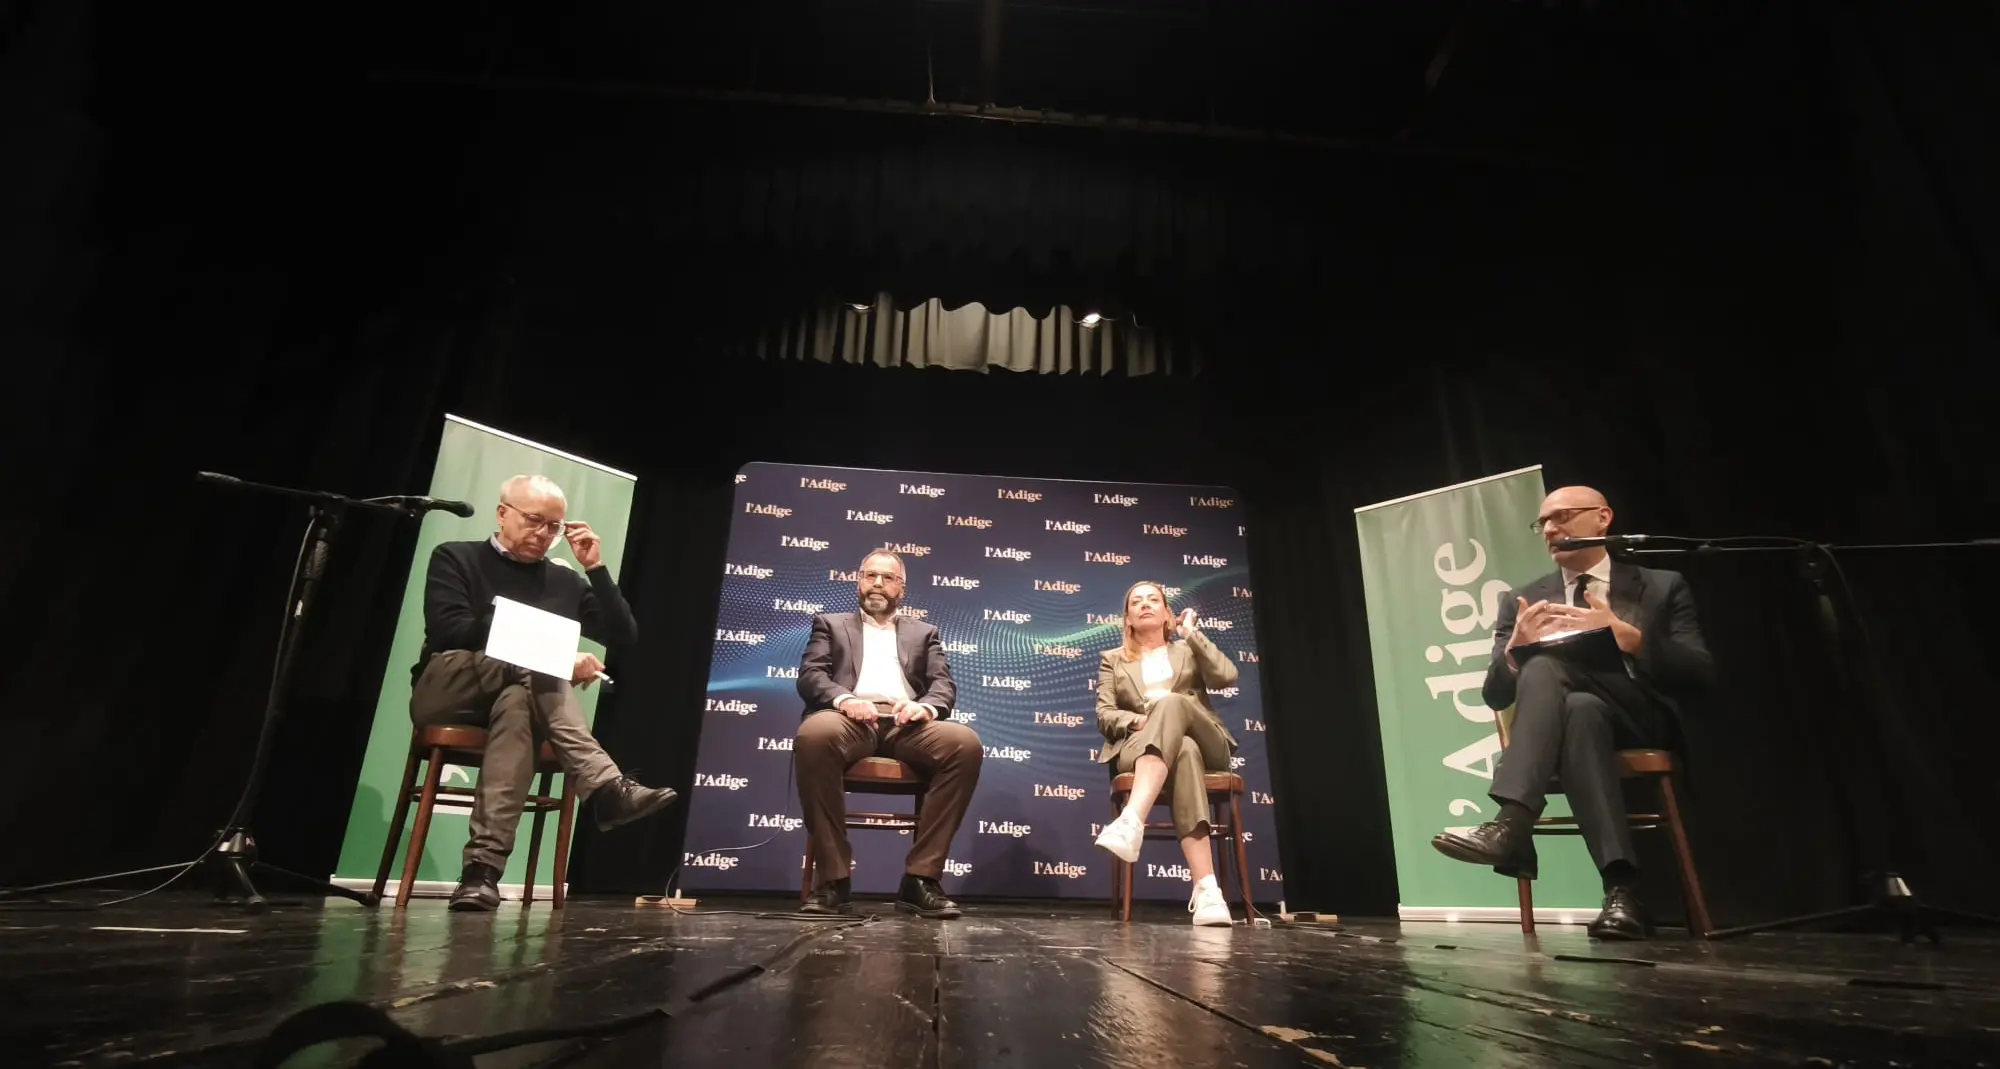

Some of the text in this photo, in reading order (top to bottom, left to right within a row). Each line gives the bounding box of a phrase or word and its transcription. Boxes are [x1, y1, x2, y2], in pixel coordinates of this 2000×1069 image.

[800, 477, 847, 492] l'Adige
[899, 483, 946, 498] l'Adige
[998, 488, 1042, 502] l'Adige
[1094, 493, 1138, 506] l'Adige
[1189, 496, 1233, 508] l'Adige
[745, 502, 792, 518] l'Adige
[846, 509, 893, 524] l'Adige
[946, 515, 993, 529] l'Adige
[1045, 520, 1091, 535] l'Adige
[1143, 523, 1188, 537] l'Adige
[781, 535, 829, 550] l'Adige
[884, 542, 931, 557] l'Adige
[985, 547, 1031, 561] l'Adige
[1084, 551, 1131, 565] l'Adige
[1183, 554, 1227, 568] l'Adige
[725, 563, 774, 578] l'Adige
[829, 570, 860, 582] l'Ad
[932, 575, 980, 590] l'Adige
[1034, 579, 1081, 594] l'Adige
[774, 599, 824, 615] l'Adige
[896, 607, 928, 619] dige
[984, 609, 1031, 624] l'Adige
[1086, 613, 1125, 626] l'Adi
[1196, 618, 1233, 630] Adige
[716, 628, 766, 644] l'Adige
[940, 640, 978, 653] Adige
[1034, 643, 1083, 658] l'Adige
[767, 666, 799, 679] l'Adi
[982, 675, 1031, 691] l'Adige
[1425, 538, 1512, 840] 'Adige
[705, 699, 758, 716] l'Adige
[1034, 712, 1084, 727] l'Adige
[758, 737, 794, 750] l'Adi
[694, 773, 748, 790] l'Adige
[1034, 784, 1085, 799] l'Adige
[748, 814, 802, 830] l'Adige
[979, 821, 1031, 837] l'Adige
[684, 853, 739, 870] l'Adige
[1034, 862, 1086, 878] l'Adige
[1147, 864, 1191, 880] l'Adig
